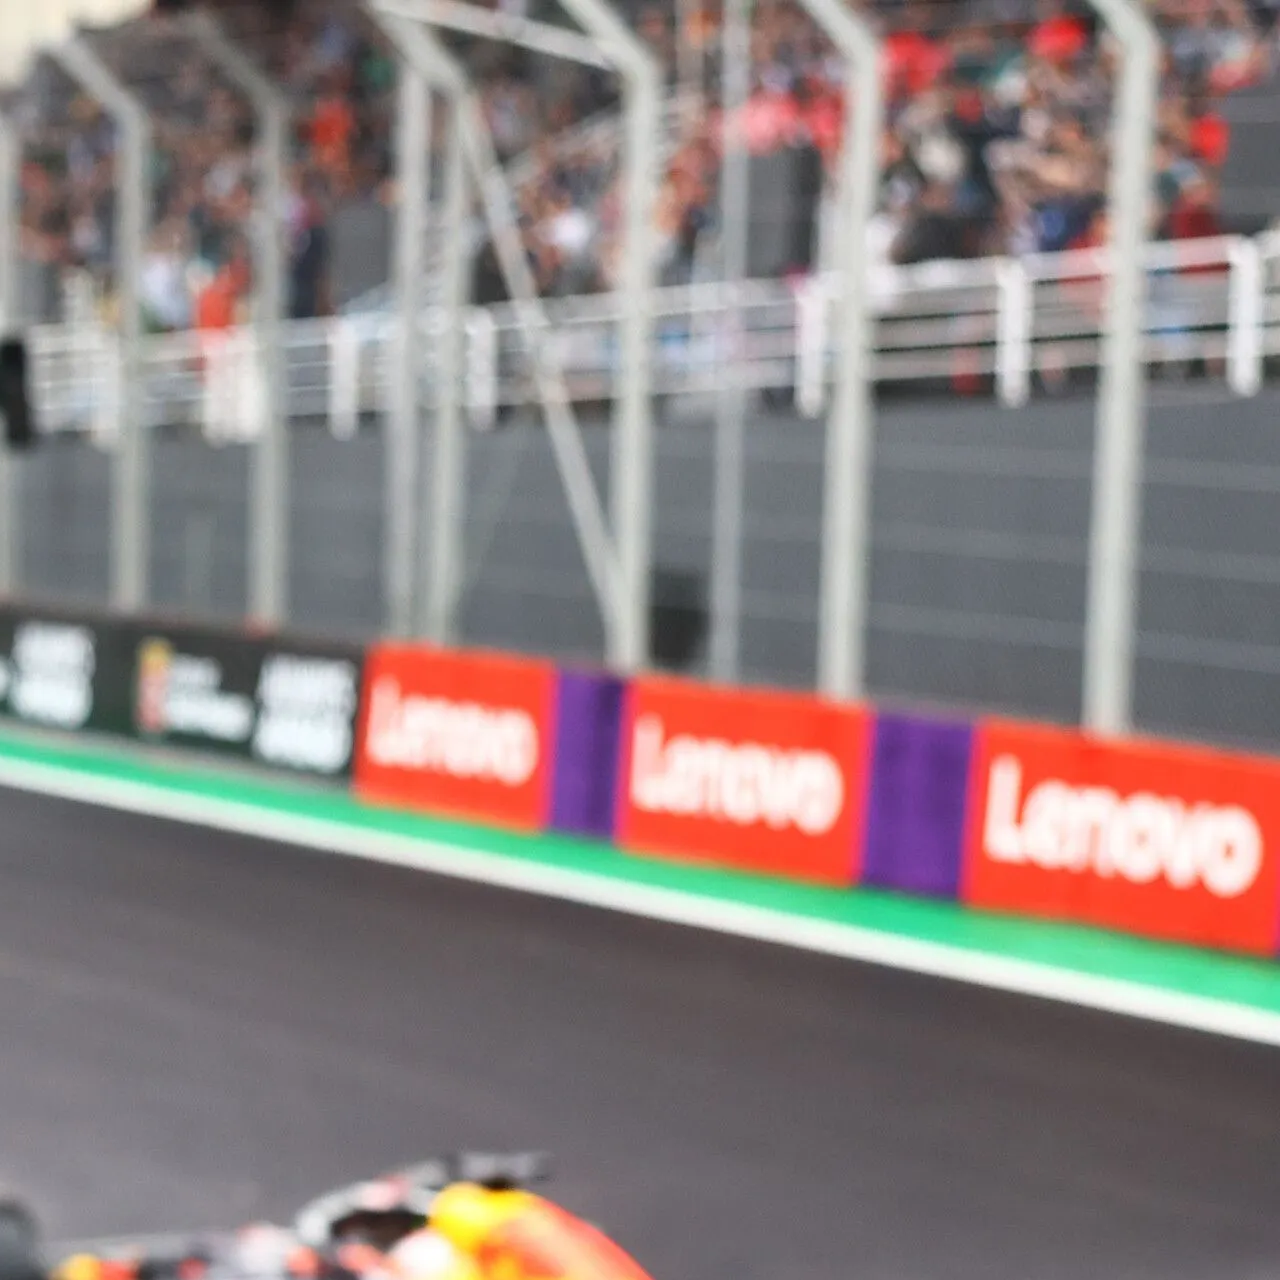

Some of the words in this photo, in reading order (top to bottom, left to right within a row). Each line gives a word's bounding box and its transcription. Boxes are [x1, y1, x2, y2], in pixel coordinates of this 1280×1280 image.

[363, 675, 540, 786] Lenovo
[630, 713, 844, 836] Lenovo
[983, 754, 1264, 898] Lenovo
